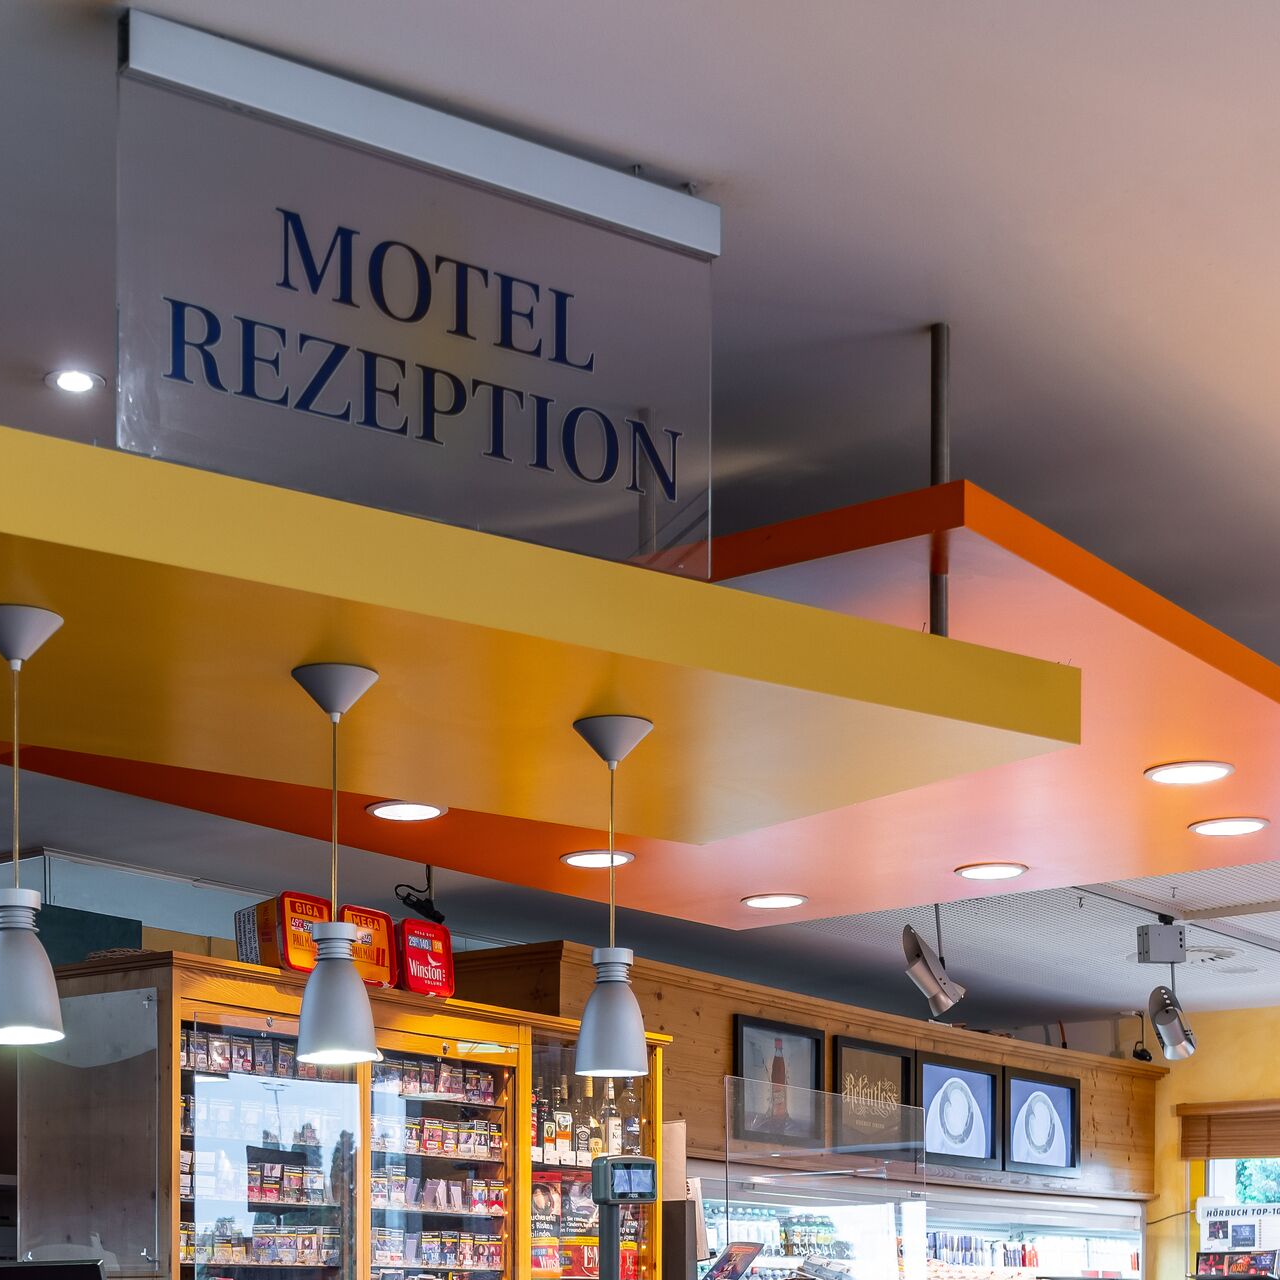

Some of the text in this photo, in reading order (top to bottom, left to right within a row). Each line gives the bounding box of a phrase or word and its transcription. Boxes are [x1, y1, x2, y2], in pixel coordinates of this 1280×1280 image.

[274, 206, 596, 374] MOTEL
[161, 295, 684, 503] REZEPTION
[295, 902, 320, 918] GIGA
[352, 914, 381, 930] MEGA
[408, 957, 442, 981] Winston
[1206, 1206, 1248, 1217] HÖRBUCH
